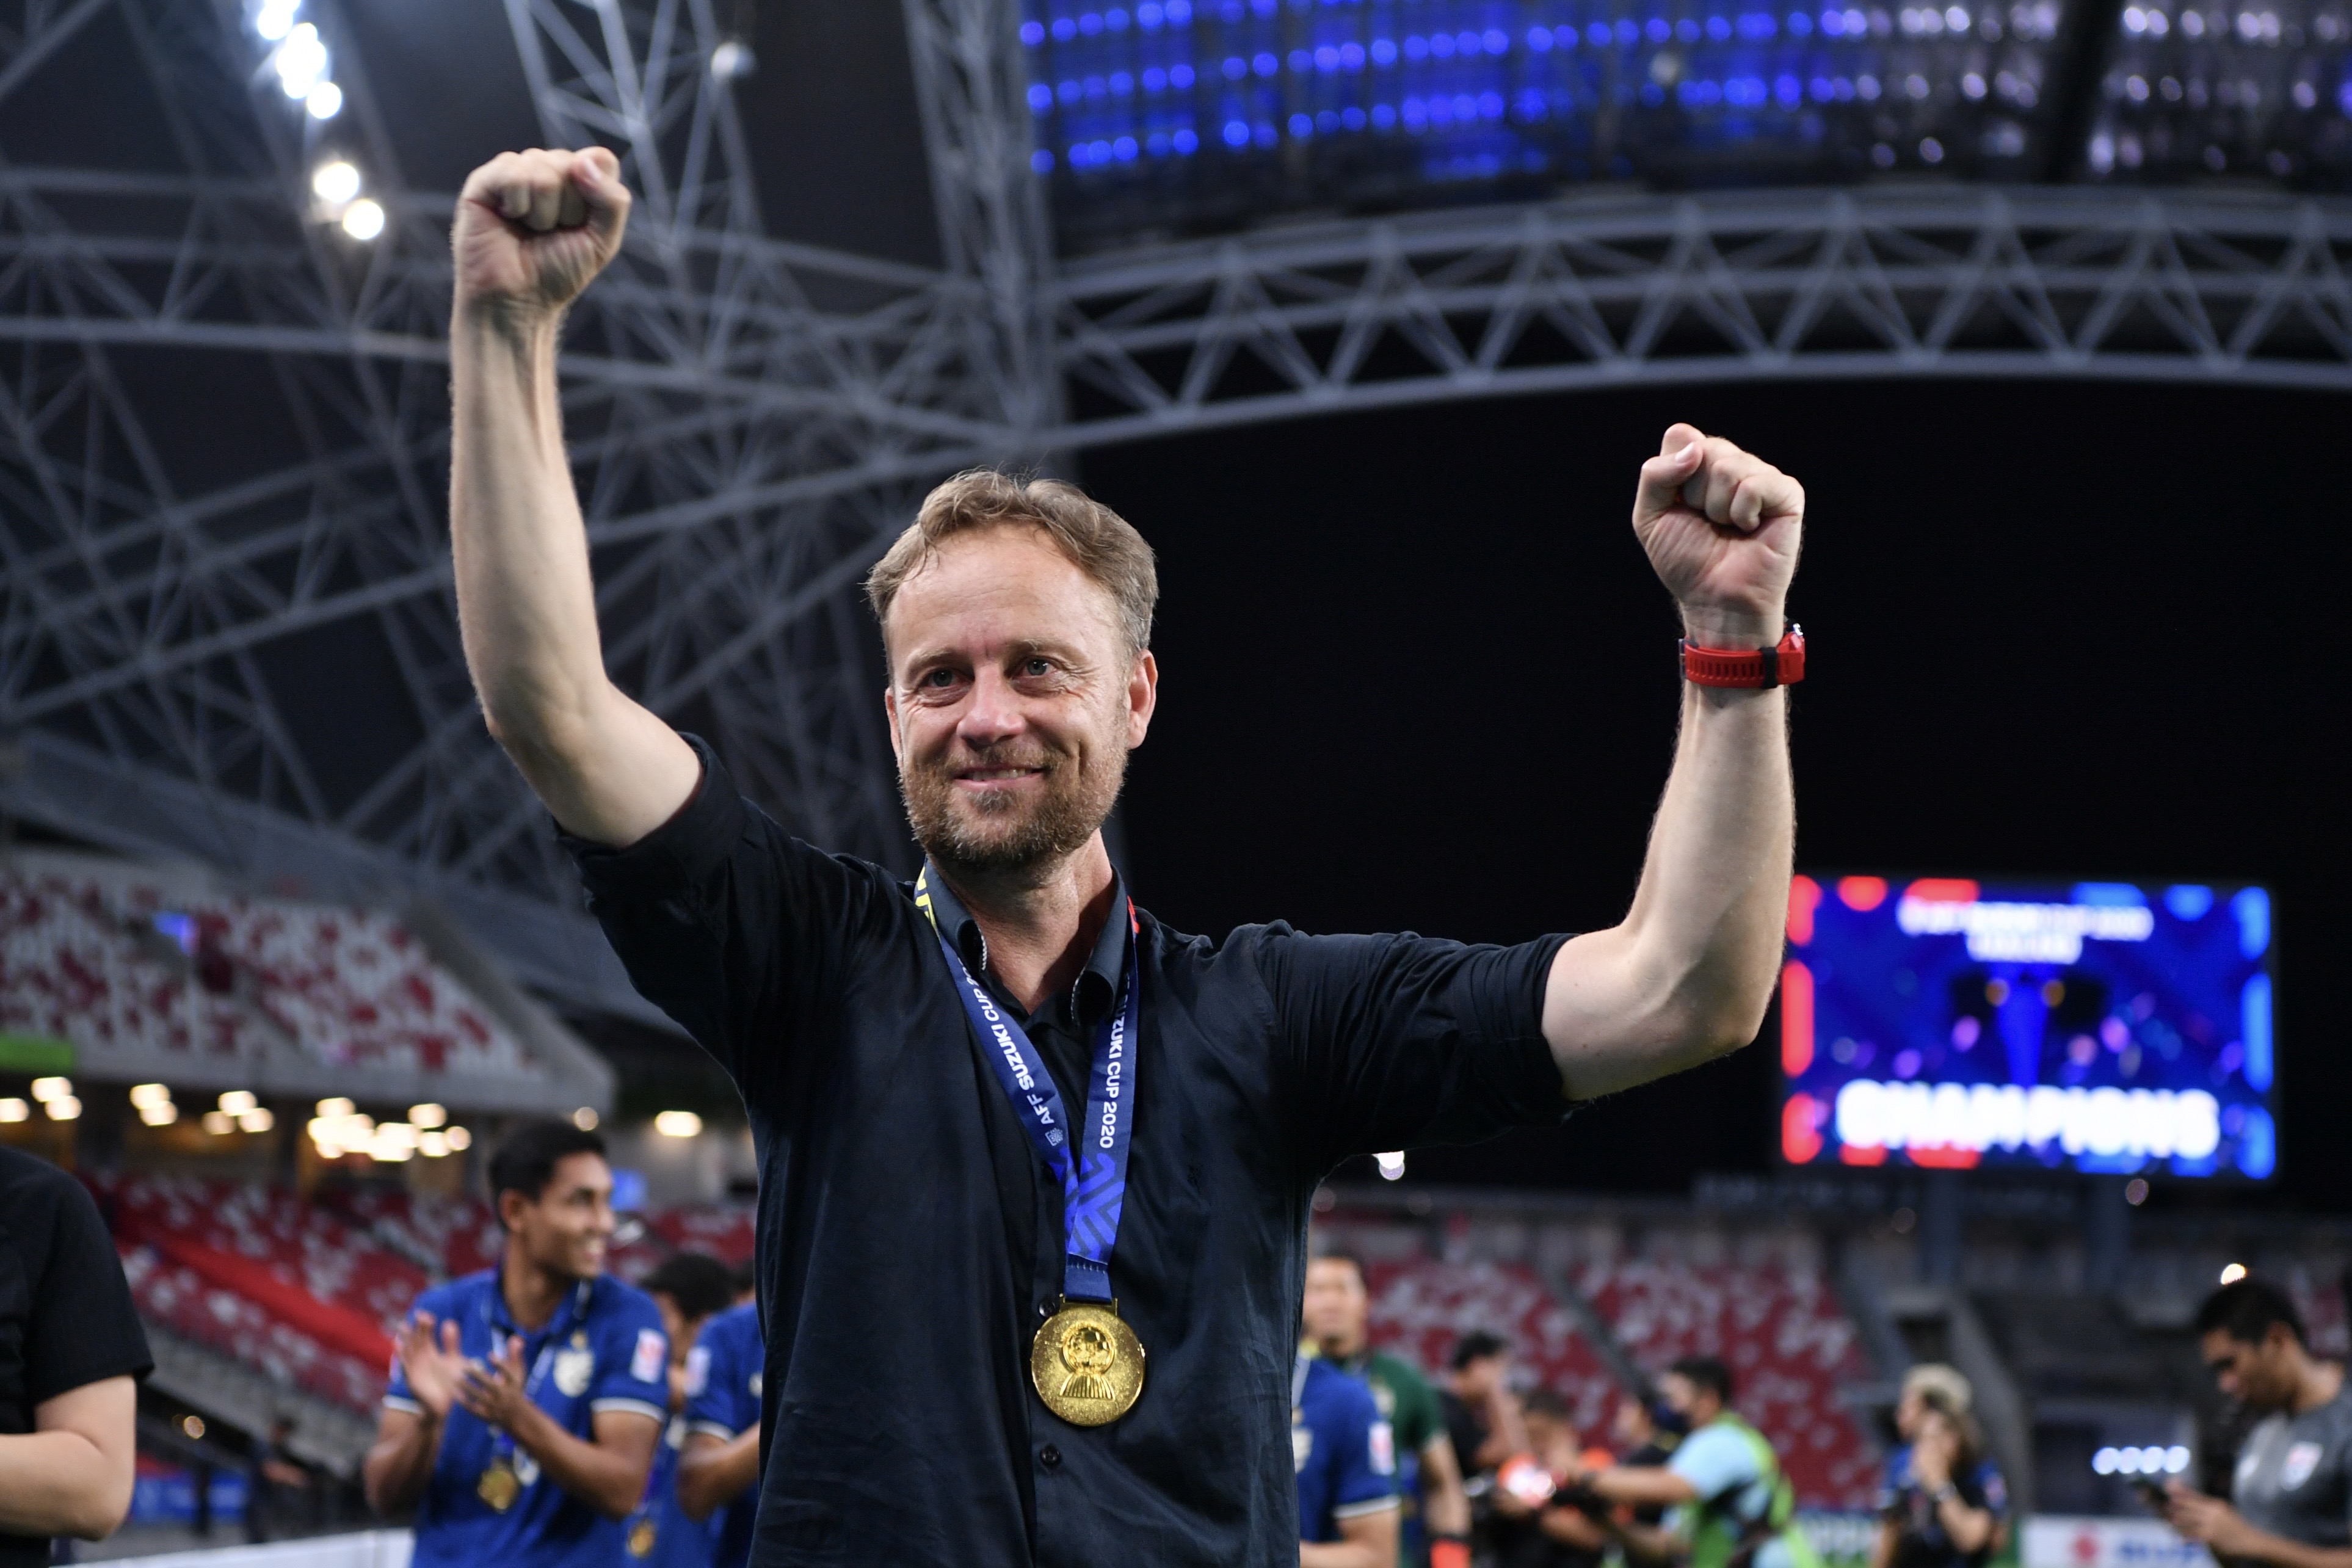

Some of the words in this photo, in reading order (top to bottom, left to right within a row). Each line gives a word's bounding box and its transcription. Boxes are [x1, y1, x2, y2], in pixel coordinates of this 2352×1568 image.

[973, 988, 1000, 1022] CUP
[990, 1023, 1035, 1091] SUZUKI
[1105, 1061, 1121, 1098] CUP
[1026, 1093, 1055, 1125] AFF
[1099, 1101, 1117, 1149] 2020
